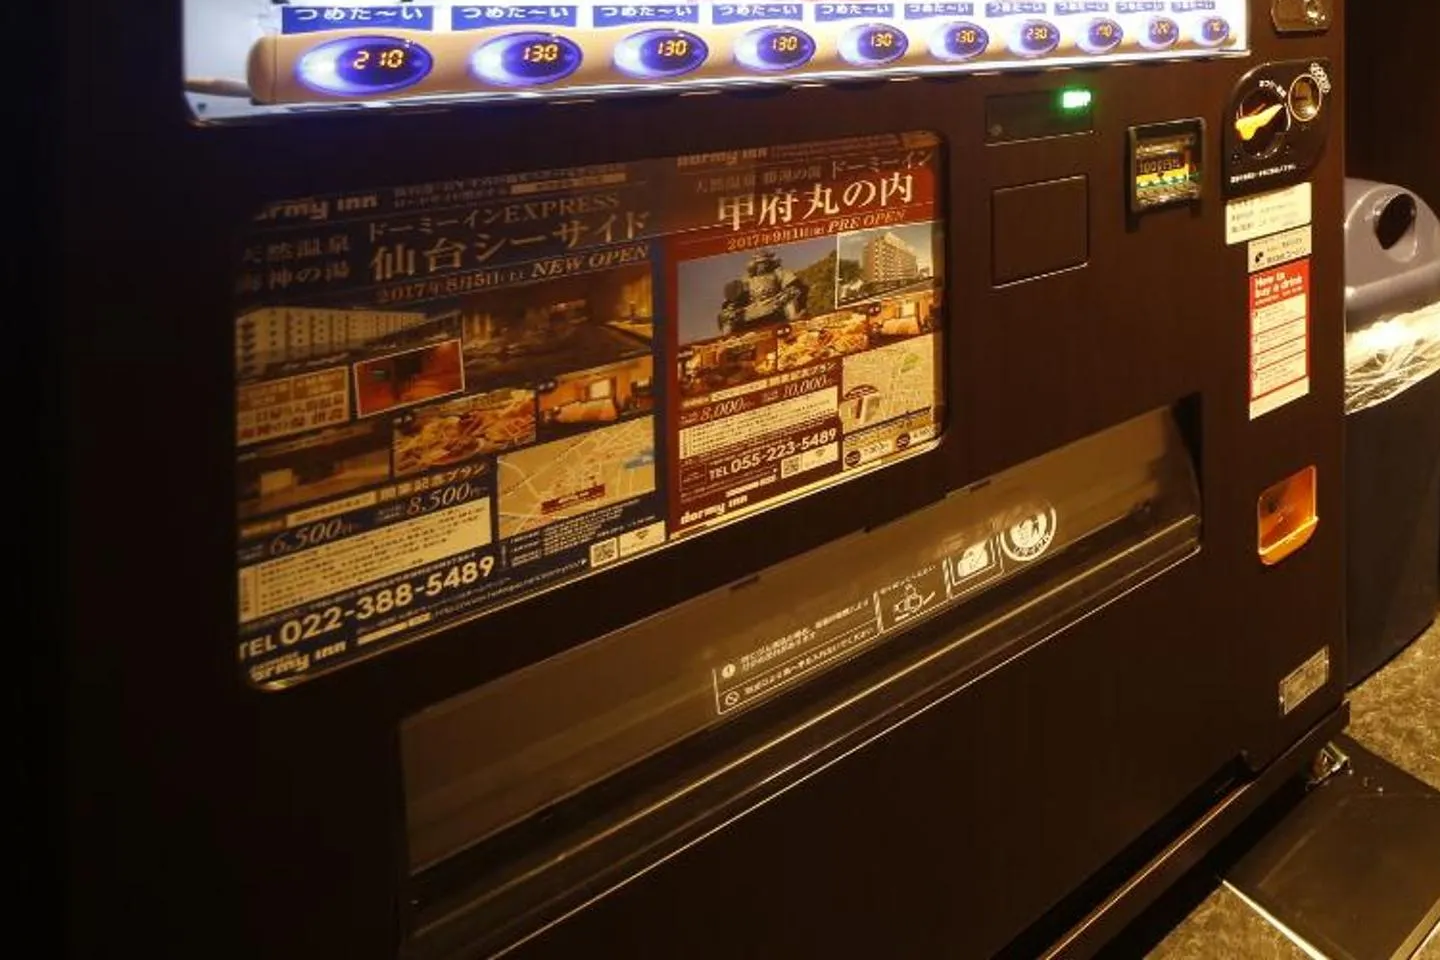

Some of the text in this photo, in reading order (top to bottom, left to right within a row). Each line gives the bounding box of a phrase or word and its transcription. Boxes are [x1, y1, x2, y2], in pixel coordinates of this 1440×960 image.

[657, 39, 687, 57] 130
[773, 35, 798, 52] 130
[871, 32, 892, 48] 130
[523, 44, 558, 63] 130
[832, 150, 933, 180] ドーミーイン
[337, 193, 378, 210] inn
[718, 171, 913, 231] 甲府丸の内
[828, 219, 860, 233] PRE
[863, 210, 905, 226] OPEN
[373, 211, 651, 281] 仙台シーサイド
[531, 257, 582, 279] NEW
[589, 244, 650, 269] OPEN
[709, 467, 728, 482] TEL
[731, 428, 837, 474] 055-223-5489
[280, 555, 495, 645] 022-388-5489
